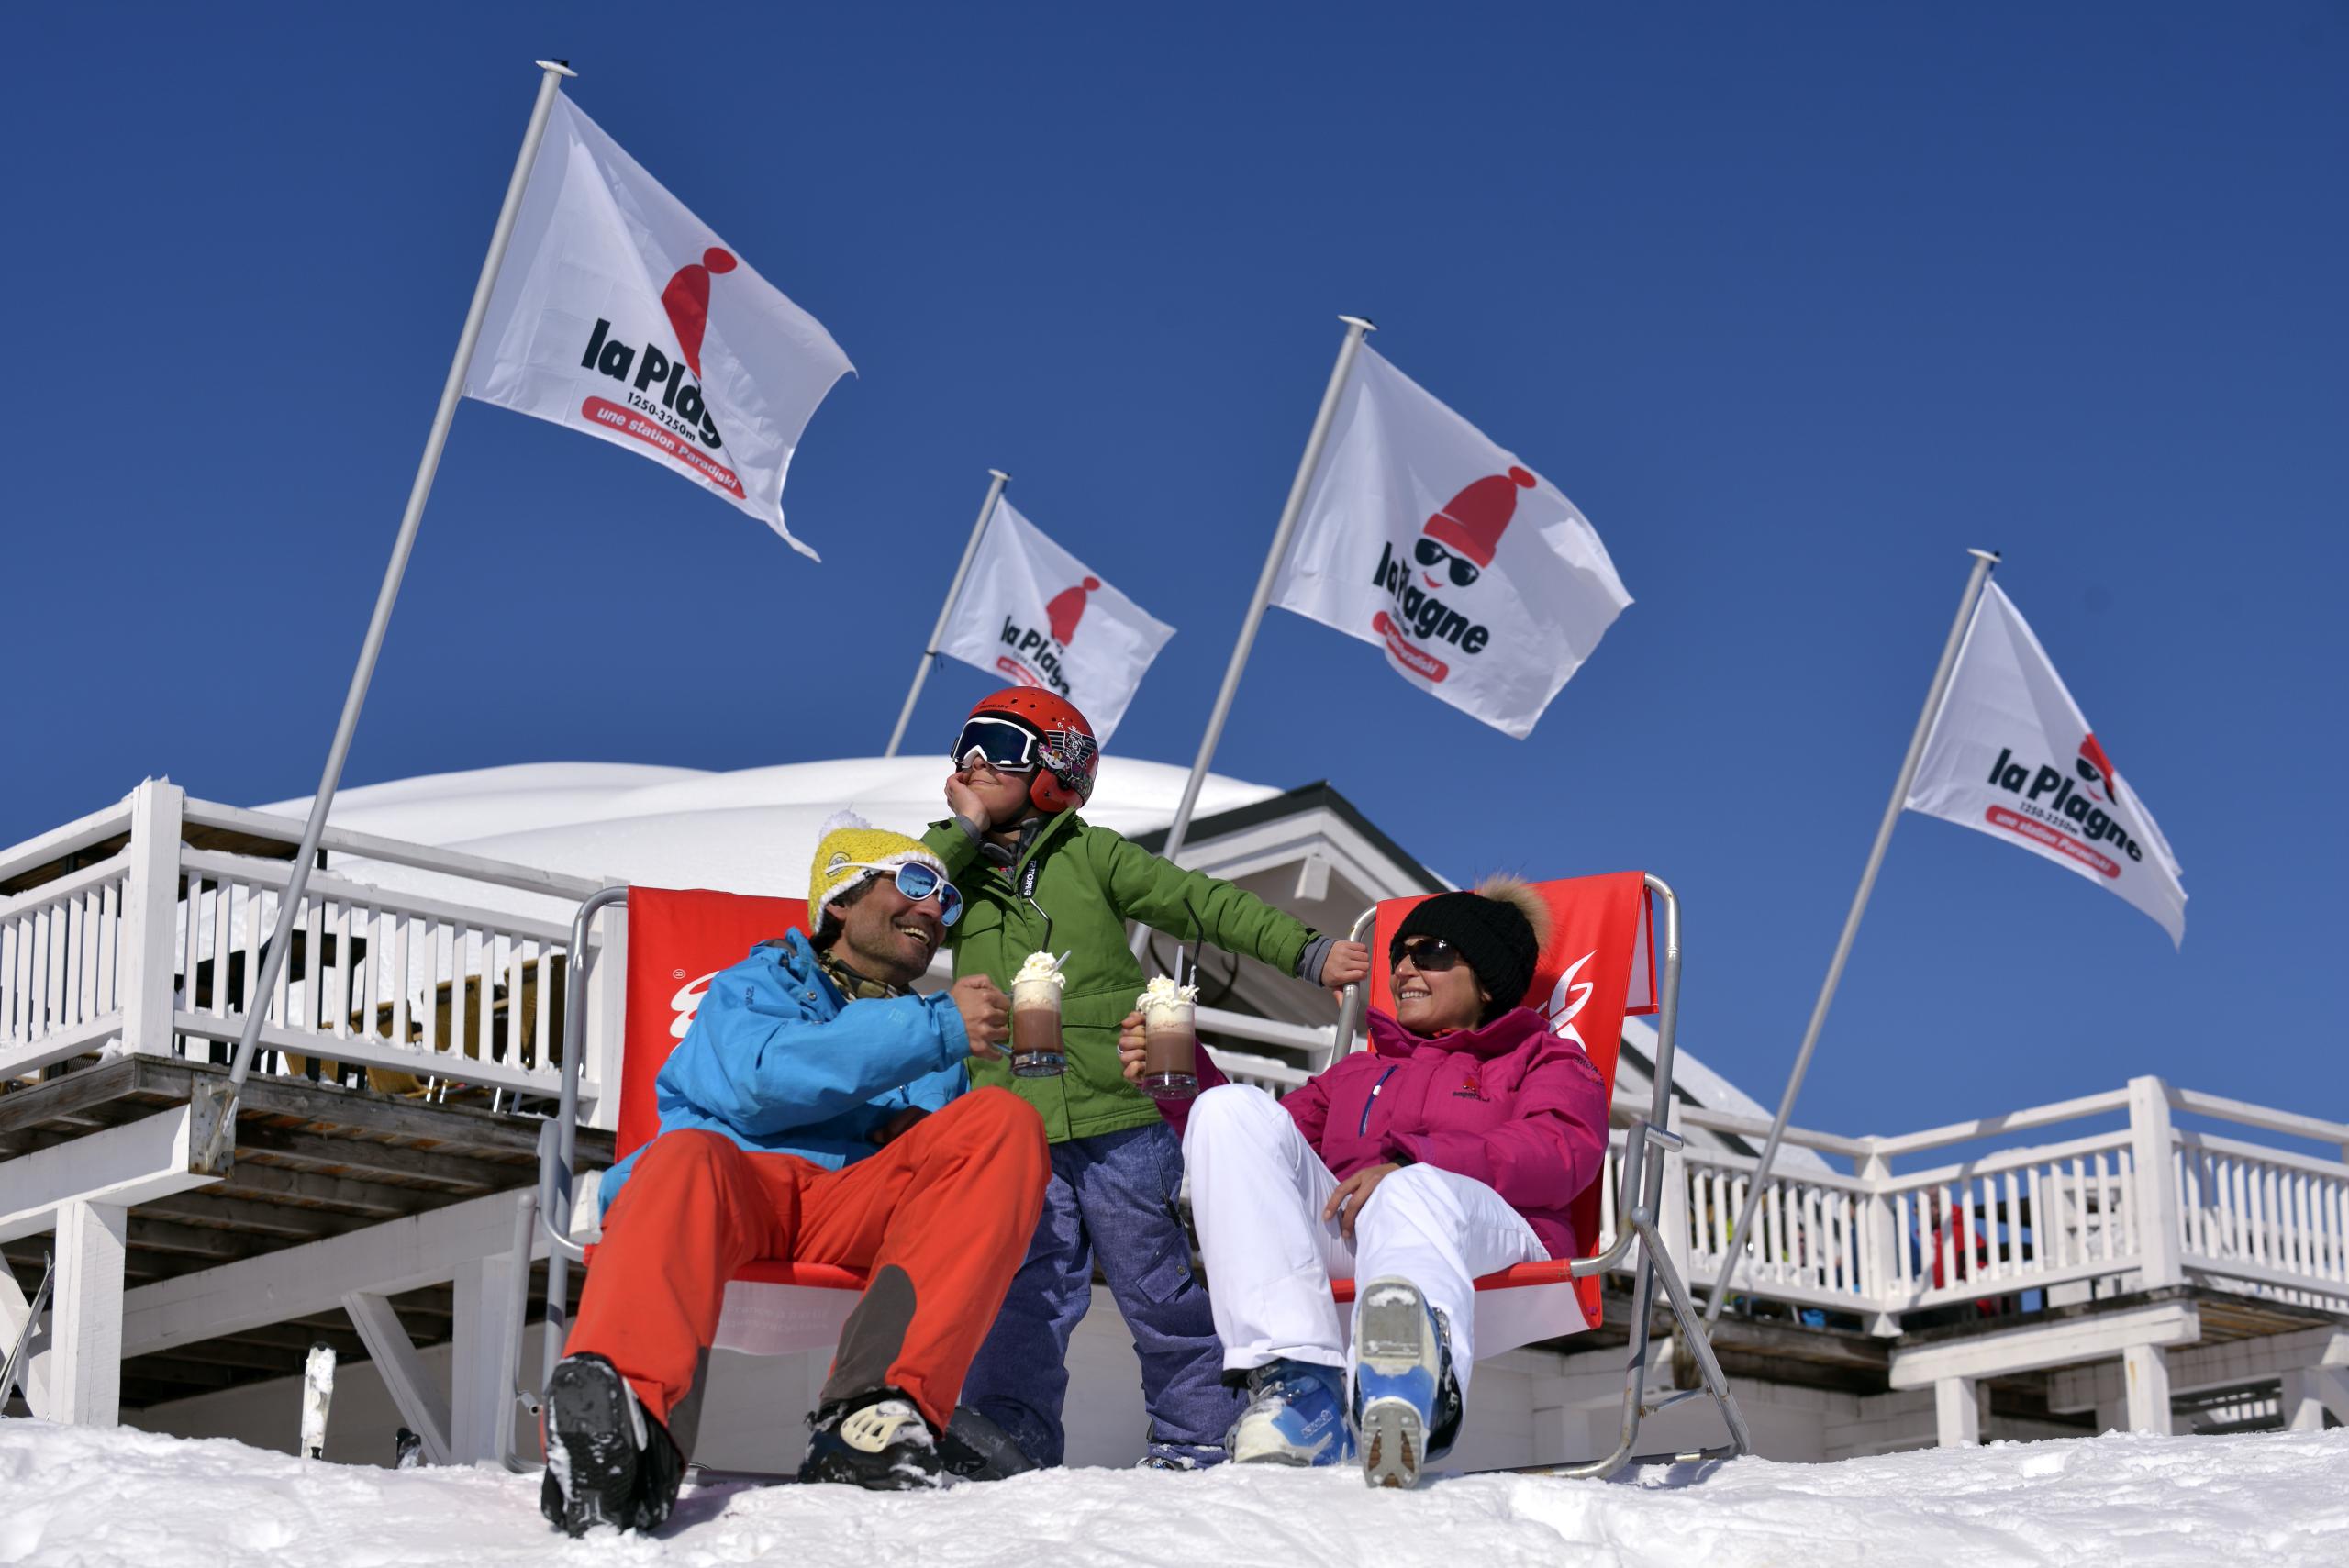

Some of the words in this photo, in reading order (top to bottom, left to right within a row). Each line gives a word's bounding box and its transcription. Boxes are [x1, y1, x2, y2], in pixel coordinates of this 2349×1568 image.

[581, 317, 636, 382] la
[627, 392, 696, 442] 1250-3250m
[597, 408, 626, 426] une
[629, 418, 675, 450] station
[678, 448, 738, 489] Paradiski
[1373, 540, 1398, 596] la
[1000, 615, 1020, 646] la
[1987, 748, 2030, 794] la
[2027, 764, 2143, 862] Plagne
